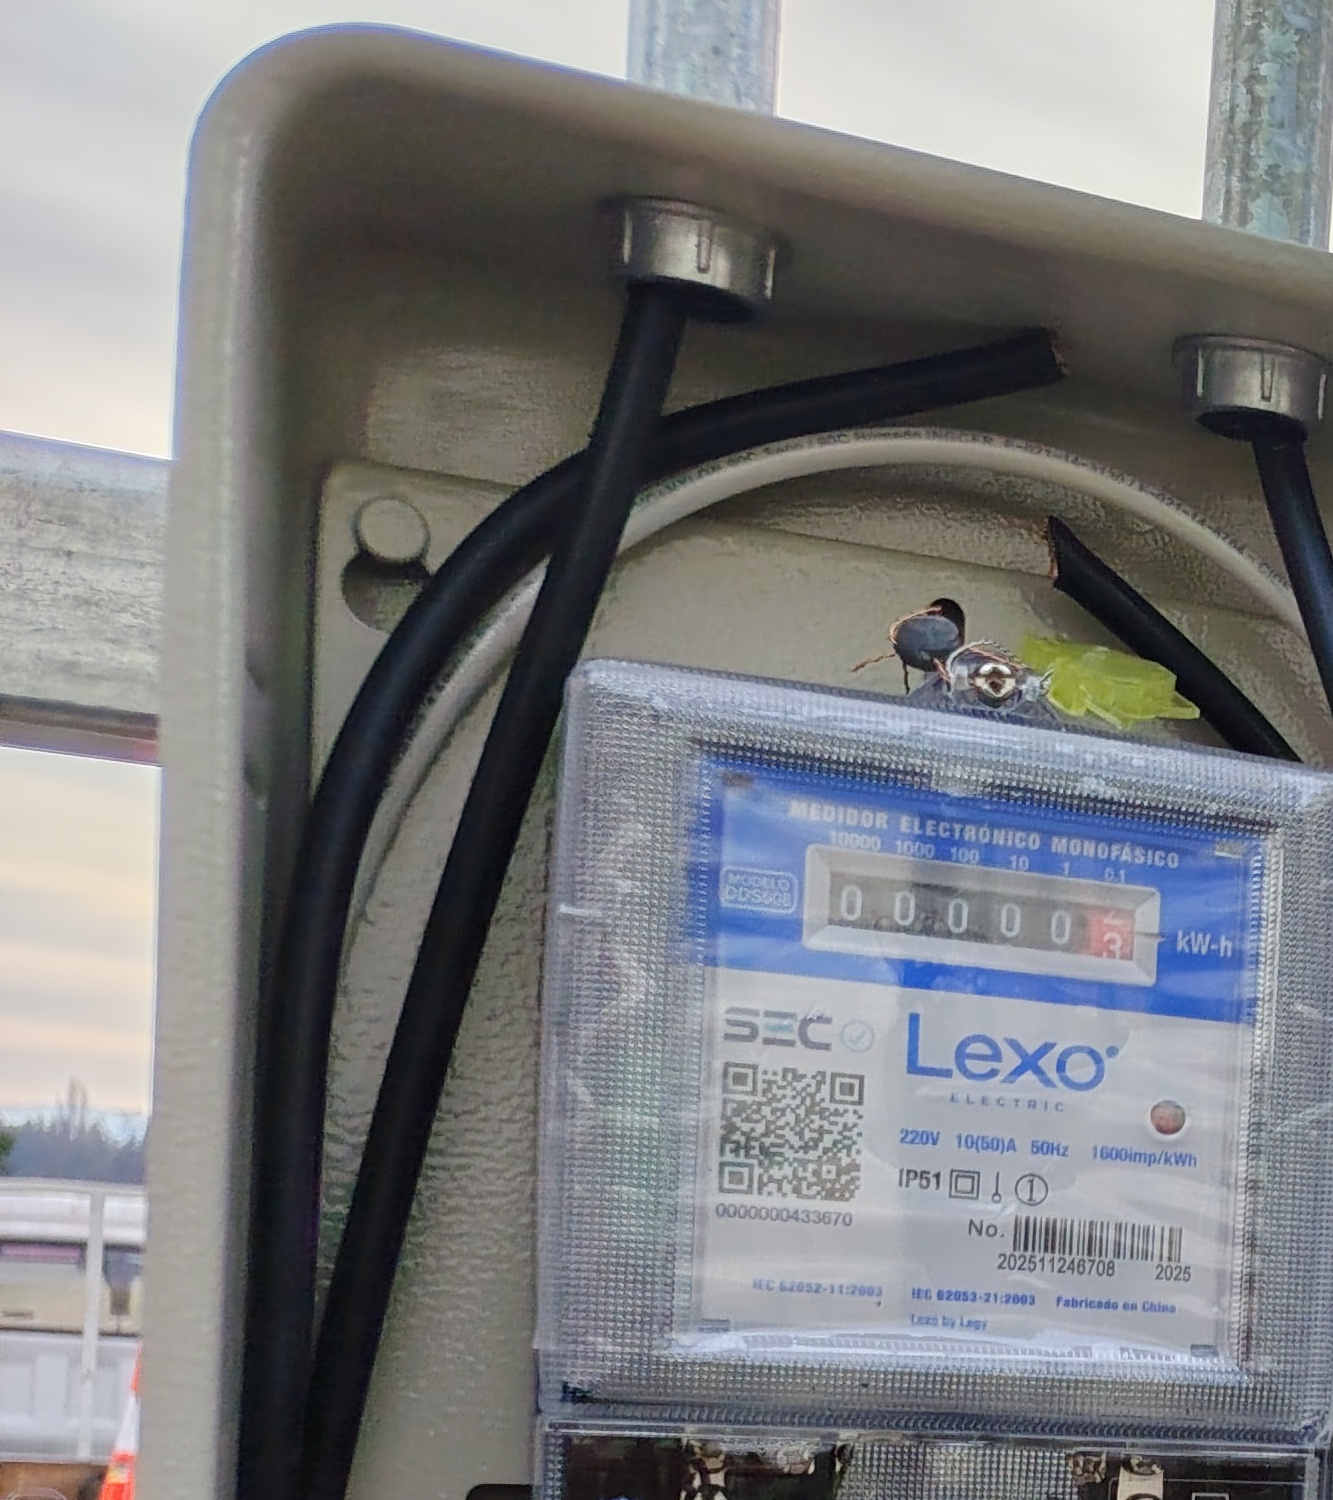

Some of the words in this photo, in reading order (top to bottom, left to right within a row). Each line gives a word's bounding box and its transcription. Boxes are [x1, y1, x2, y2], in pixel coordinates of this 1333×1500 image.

[950, 846, 980, 865] 100
[1010, 854, 1030, 872] 10
[1050, 832, 1180, 869] MONOFÁSICO
[1175, 929, 1233, 959] kW-h
[723, 1006, 833, 1051] SEC
[906, 1011, 1107, 1092] Lexo
[949, 1093, 1066, 1113] ELECTRIC
[899, 1128, 941, 1148] 220V
[955, 1133, 1017, 1155] 10(50)A
[1030, 1139, 1070, 1158] 50Hz
[898, 1168, 941, 1191] IP51
[968, 1219, 1005, 1238] No.
[1154, 1264, 1192, 1283] 2025
